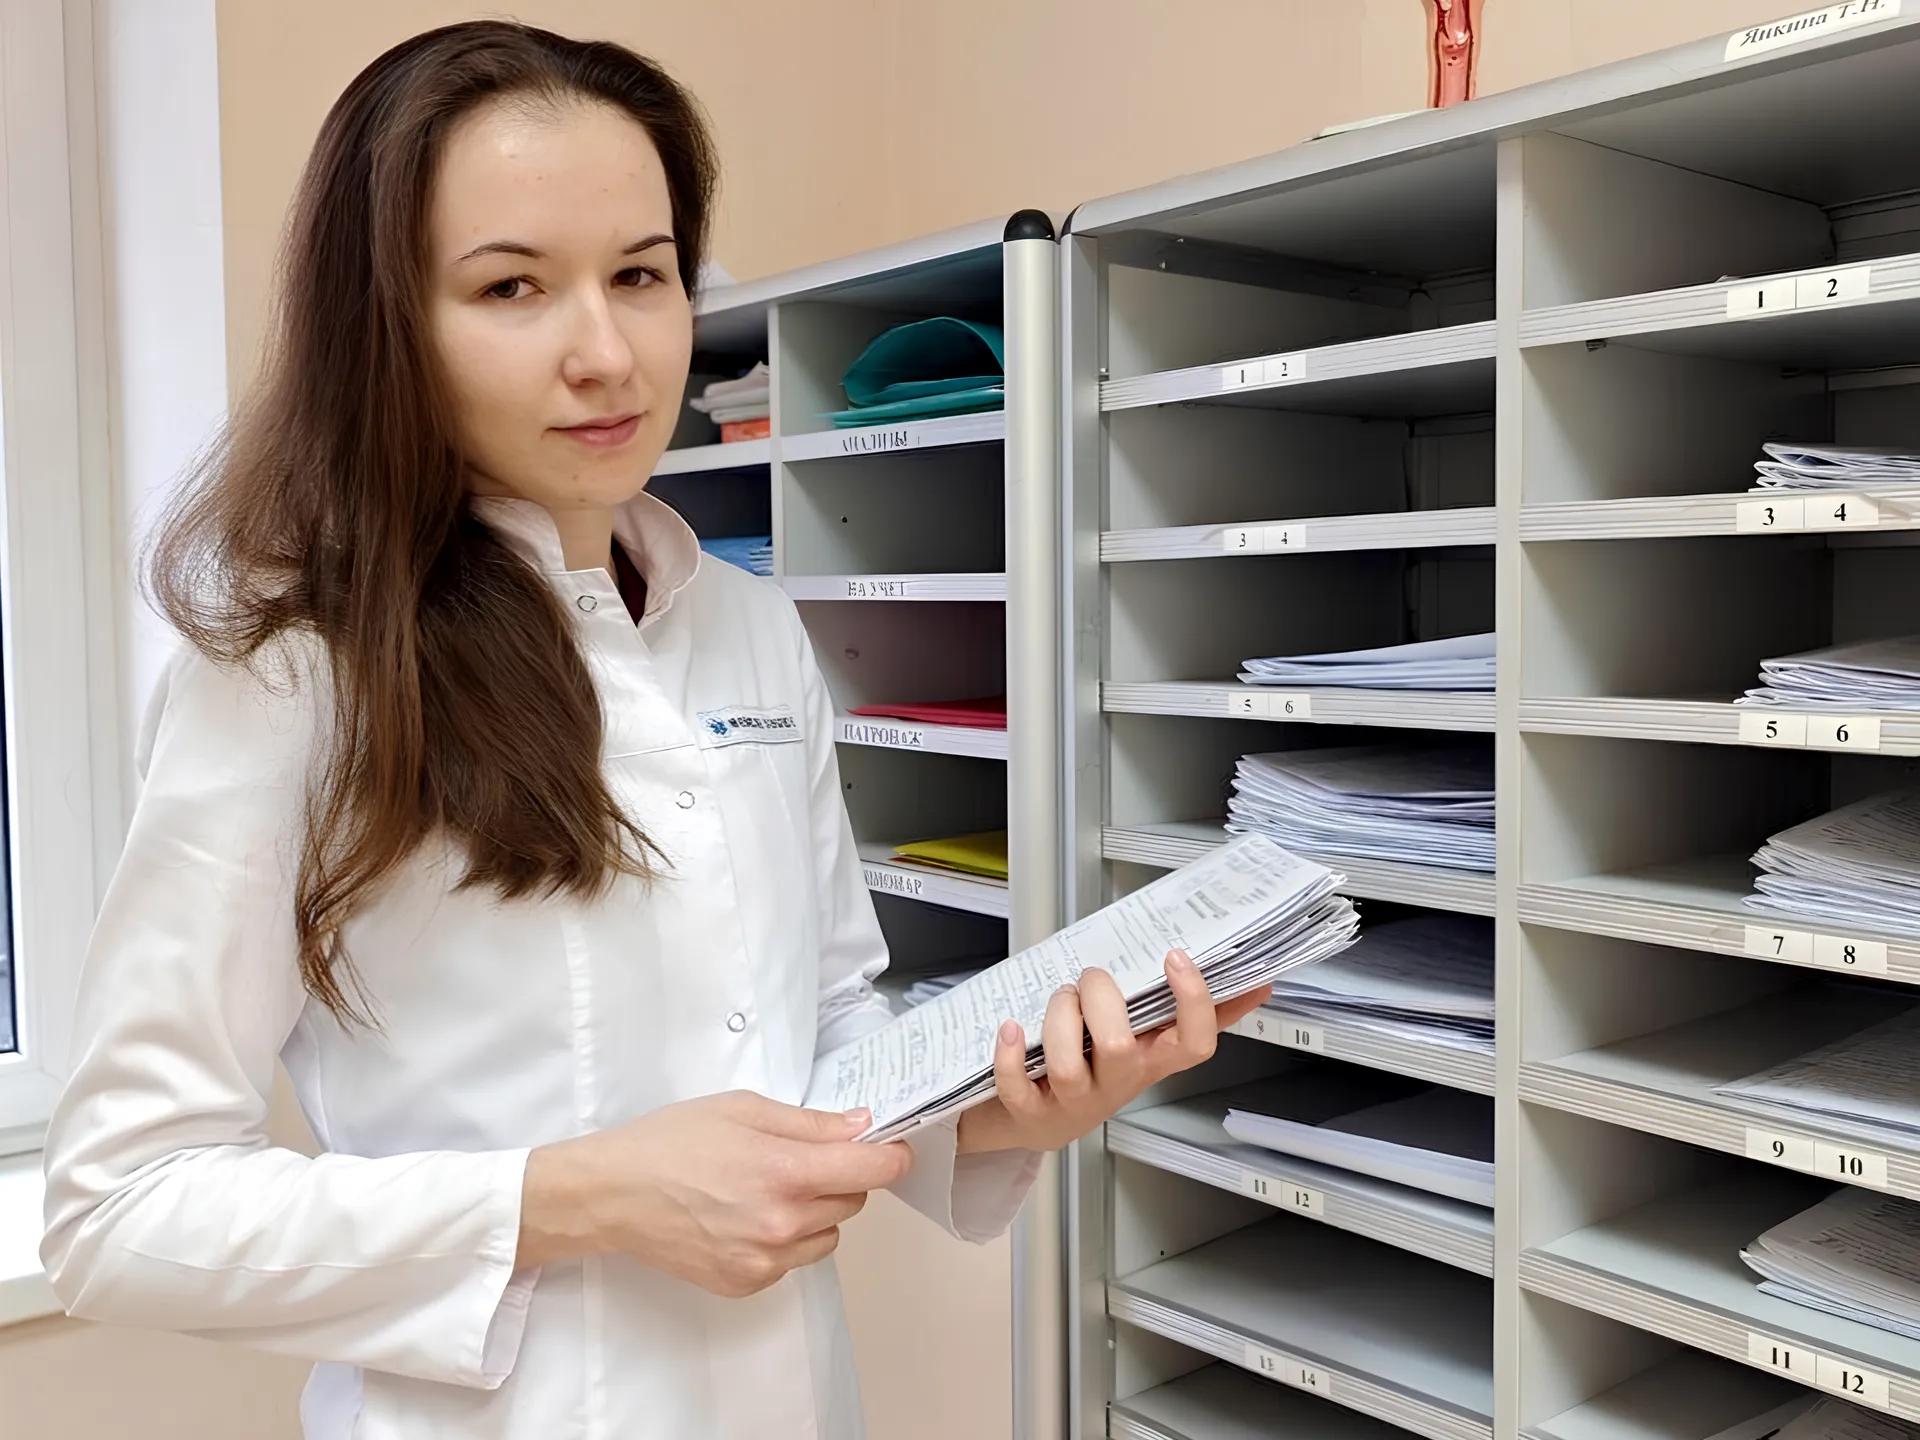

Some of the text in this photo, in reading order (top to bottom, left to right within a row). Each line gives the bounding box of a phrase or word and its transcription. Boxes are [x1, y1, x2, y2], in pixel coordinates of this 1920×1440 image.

[1757, 278, 1838, 309] 1 2
[1762, 503, 1847, 526] 3 4
[1239, 532, 1246, 548] 3
[1285, 700, 1294, 714] 6
[1765, 720, 1849, 743] 5 6
[1773, 935, 1856, 965] 7 8
[1295, 1028, 1310, 1046] 10
[1772, 1140, 1863, 1176] 9 10
[1254, 1178, 1310, 1208] 11 12
[1772, 1347, 1864, 1394] 11 12
